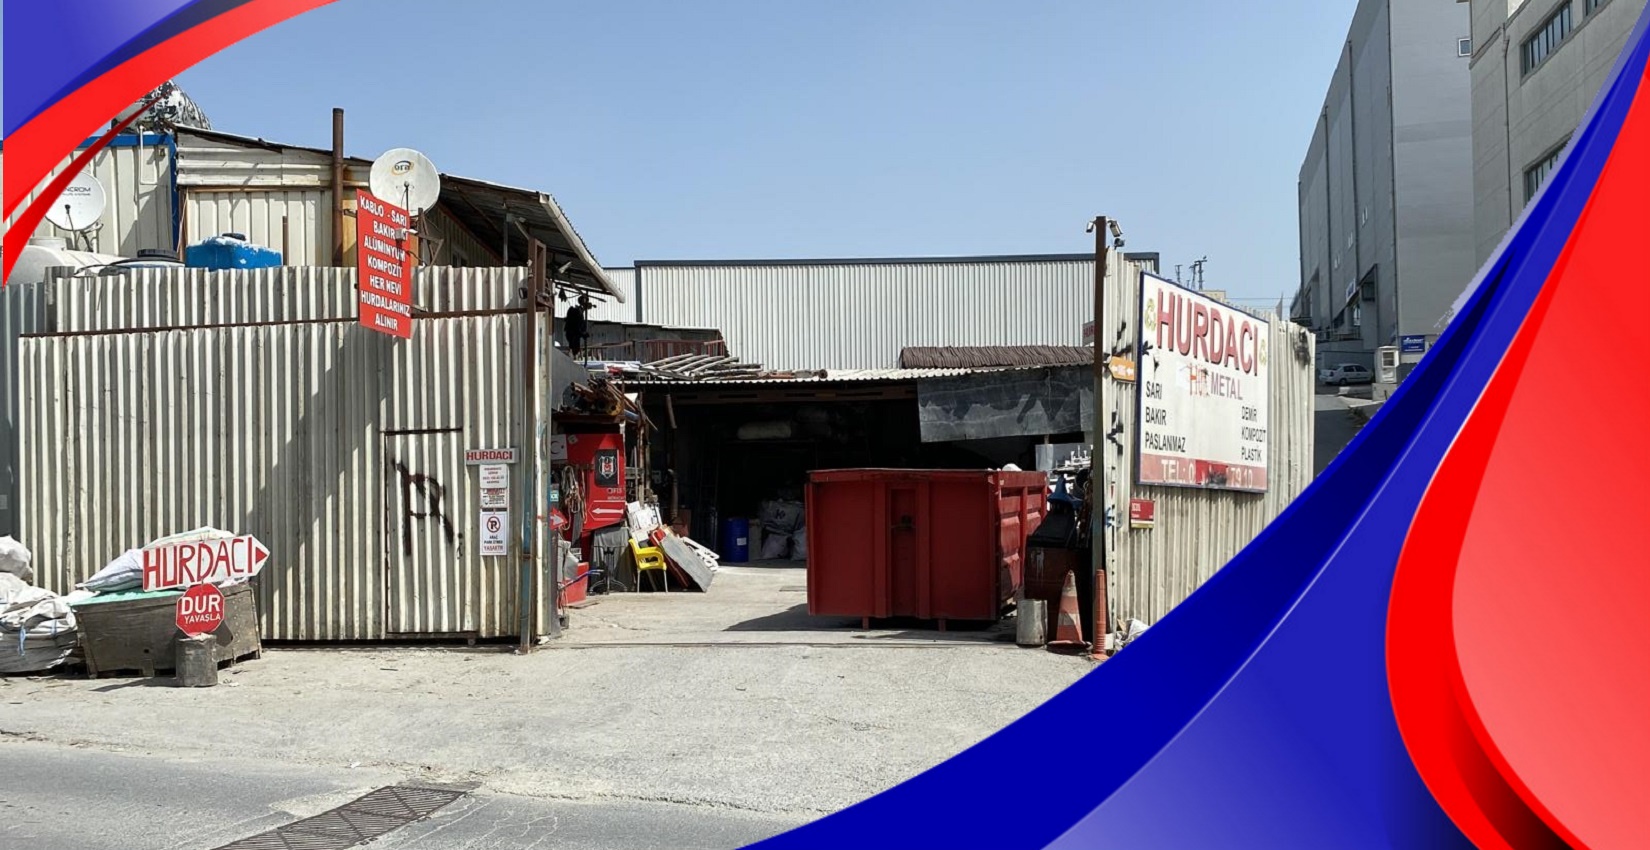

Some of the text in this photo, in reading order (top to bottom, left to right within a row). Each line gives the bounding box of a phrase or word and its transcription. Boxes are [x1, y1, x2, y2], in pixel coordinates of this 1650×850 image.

[360, 195, 384, 217] KABLO
[391, 209, 407, 226] SARI
[373, 220, 396, 240] BAKIR
[364, 235, 406, 262] ALÜMİNYUM
[367, 254, 402, 278] KOMPOZİT
[369, 275, 402, 296] HER NEVİ
[361, 290, 411, 317] HURDALARINIZ
[375, 313, 398, 331] ALINIR
[1157, 287, 1259, 377] HURDACI
[1145, 380, 1162, 400] SARI
[1210, 371, 1243, 400] METAL
[1145, 406, 1167, 426] BAKIR
[1145, 431, 1186, 453] PASLANMAZ
[466, 450, 513, 461] HURDACI
[143, 537, 253, 591] HURDACI
[181, 594, 221, 615] DUR
[184, 613, 222, 625] YAVAŞLA
